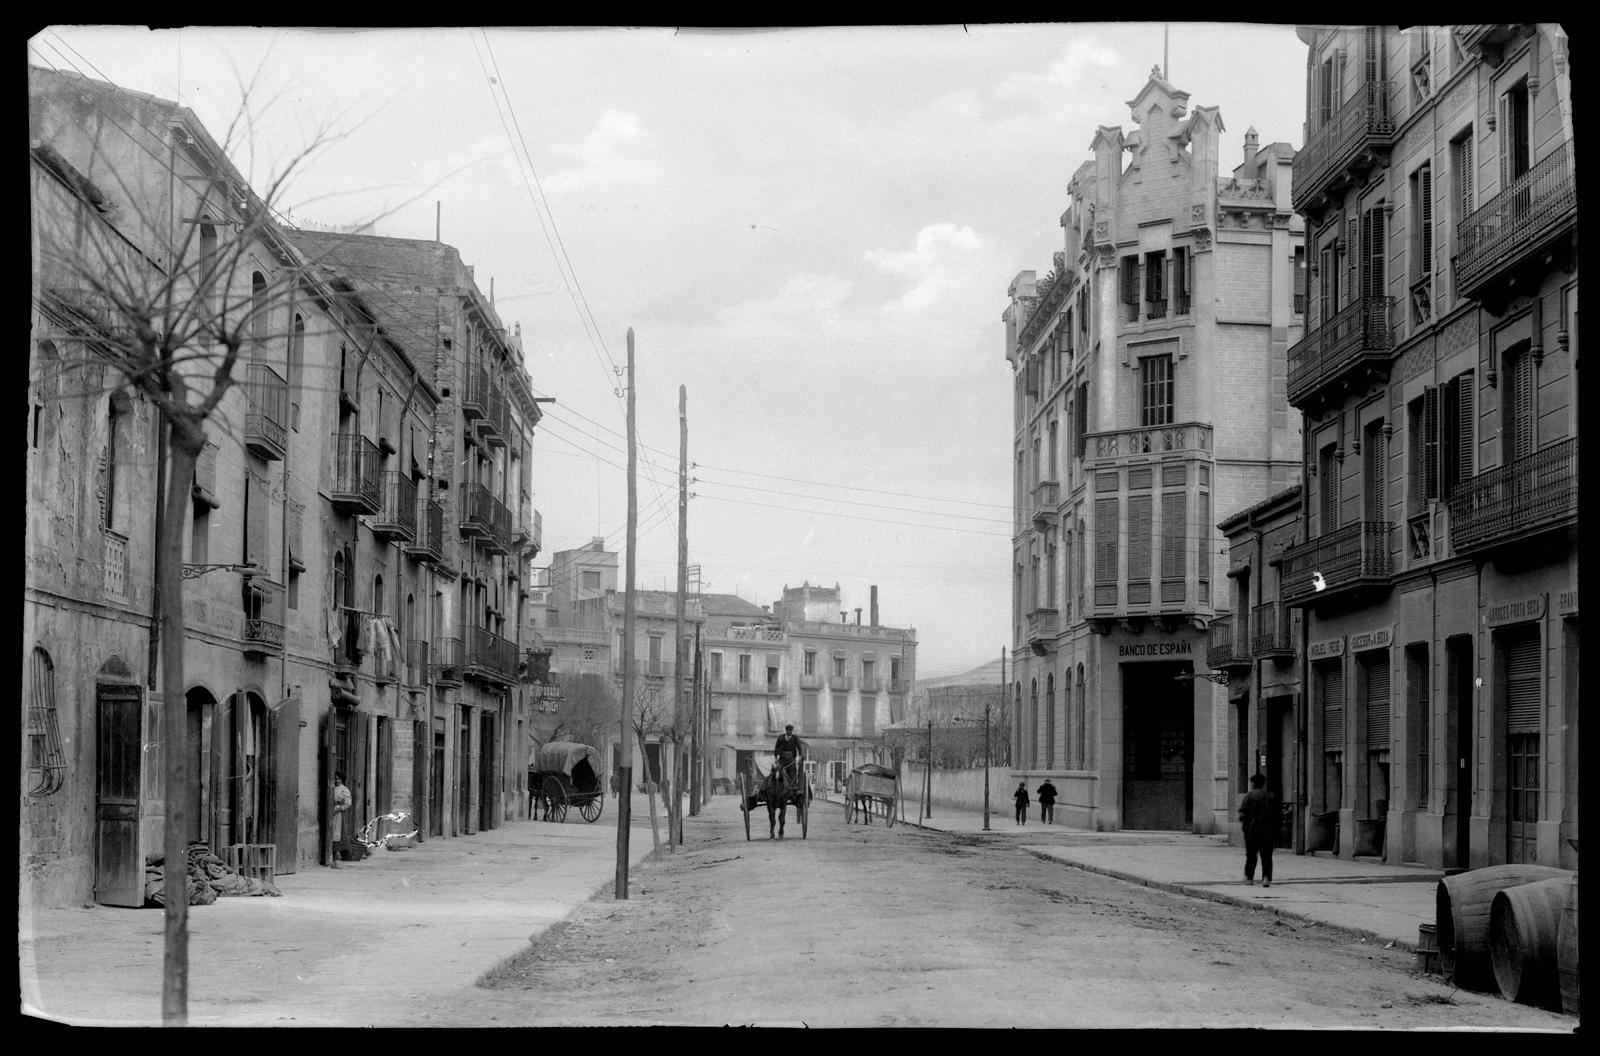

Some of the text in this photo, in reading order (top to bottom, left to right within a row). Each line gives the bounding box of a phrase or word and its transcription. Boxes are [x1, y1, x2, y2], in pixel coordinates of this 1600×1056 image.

[1527, 599, 1539, 615] SECA
[1119, 640, 1192, 656] BANCO DE ESPAÑA
